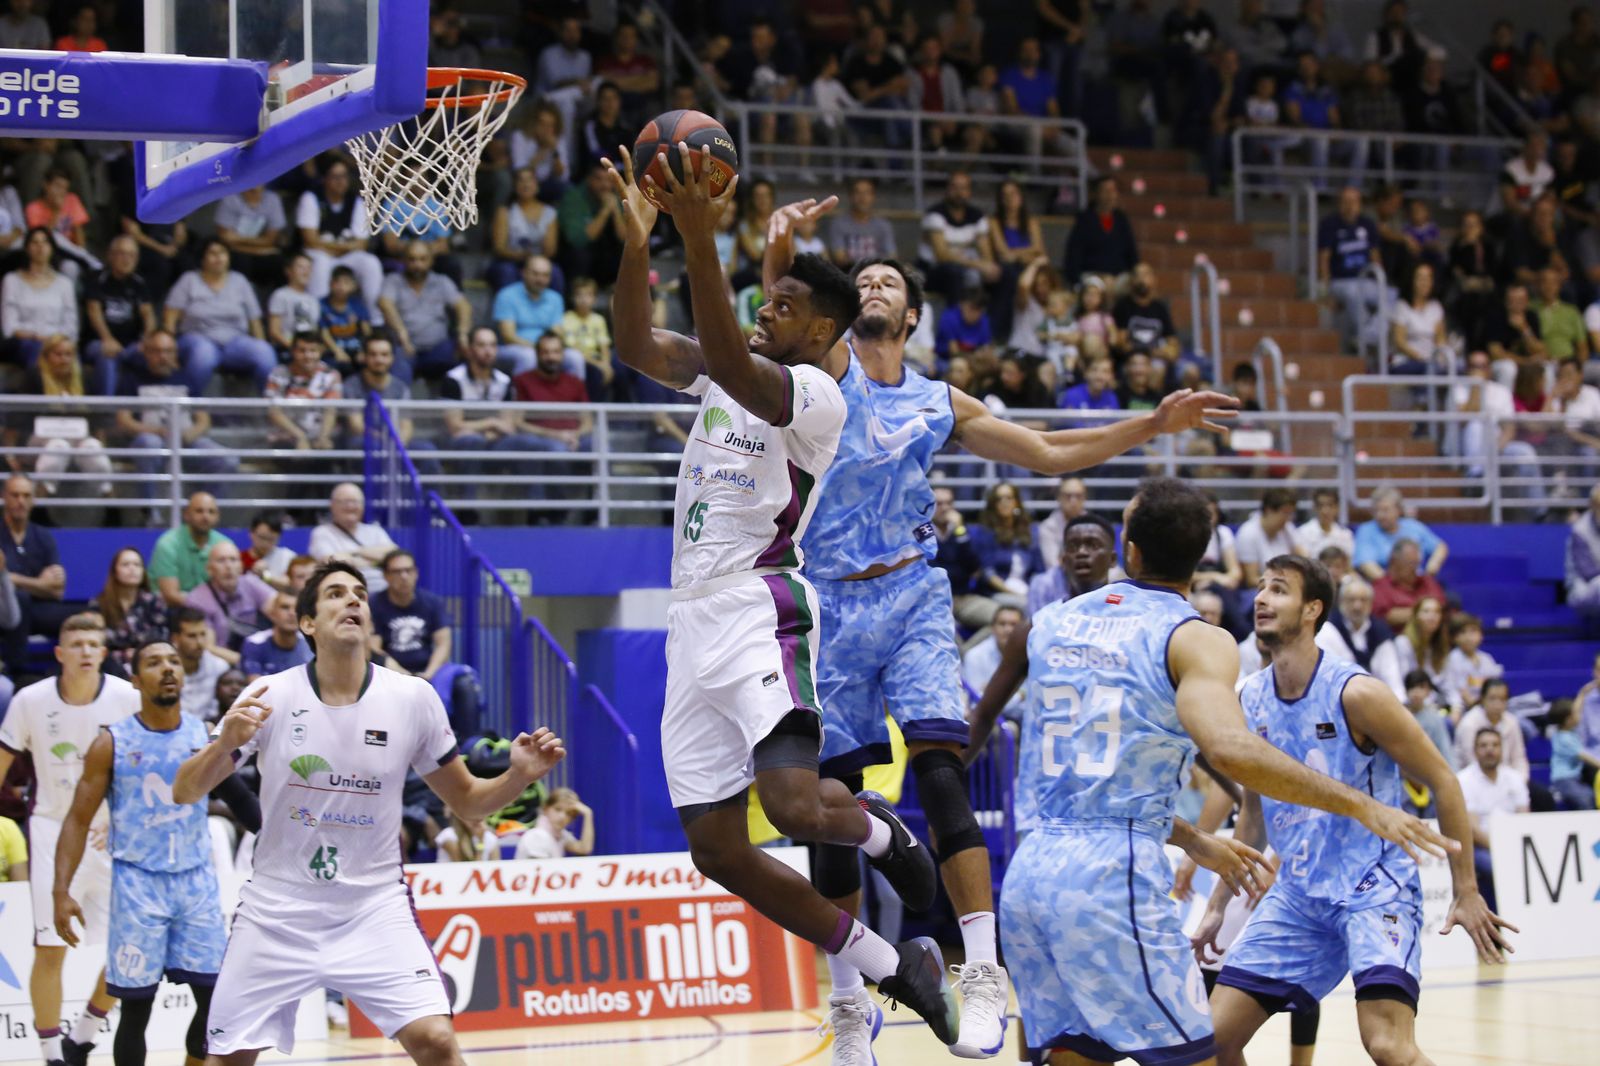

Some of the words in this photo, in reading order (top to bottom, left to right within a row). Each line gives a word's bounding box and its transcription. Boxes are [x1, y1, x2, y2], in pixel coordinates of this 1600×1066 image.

[710, 469, 756, 491] ALAGA
[683, 500, 709, 543] 15
[1041, 684, 1124, 777] 23
[329, 773, 382, 792] Unicaja
[309, 845, 338, 880] 43
[1291, 839, 1309, 877] 2
[1522, 834, 1600, 905] M
[460, 866, 581, 896] Mejor
[523, 986, 632, 1018] Rotulos
[636, 988, 655, 1018] y
[658, 979, 753, 1009] Vinilos
[0, 1012, 27, 1039] la
